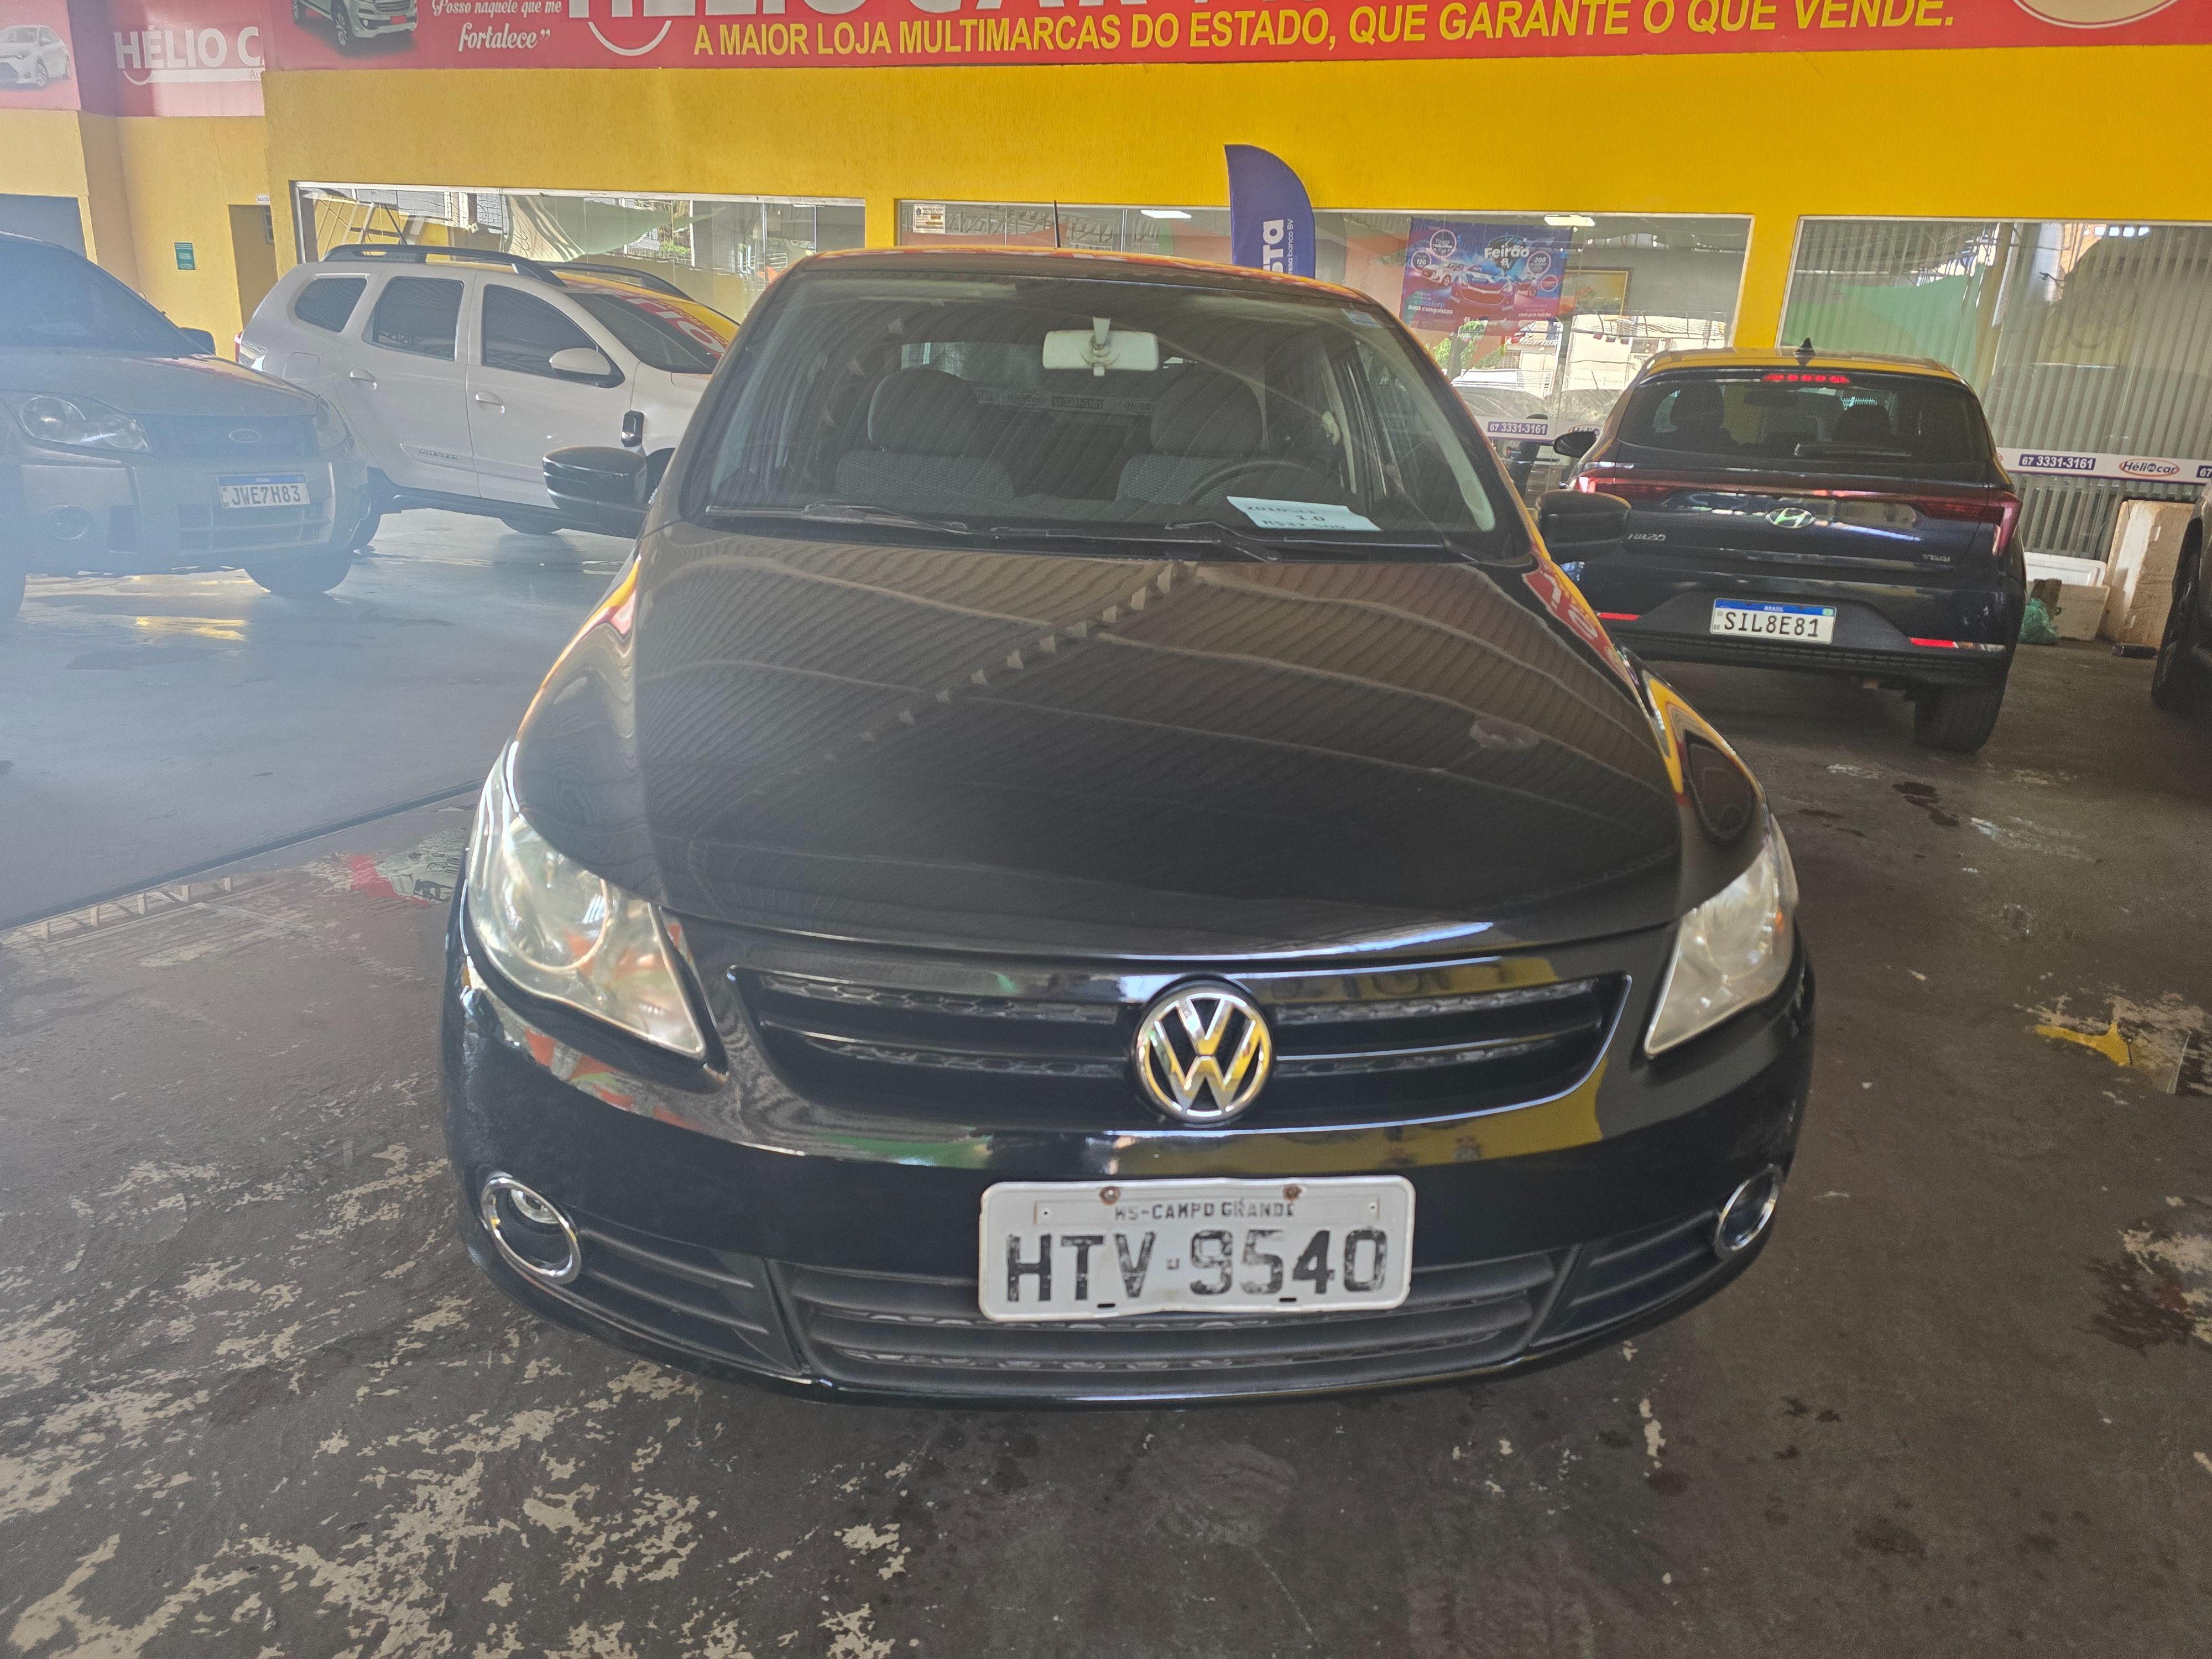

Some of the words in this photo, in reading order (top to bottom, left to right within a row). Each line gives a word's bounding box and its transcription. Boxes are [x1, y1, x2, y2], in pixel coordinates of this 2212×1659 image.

[474, 0, 517, 18] naquele
[521, 0, 542, 18] que
[545, 1, 562, 13] me
[694, 24, 713, 55] A
[721, 23, 808, 55] MAIOR
[818, 22, 891, 54] LOJA
[900, 14, 1120, 54] MULTIMARCAS
[1131, 13, 1179, 48] DO
[1190, 8, 1336, 51] ESTADO,
[1349, 4, 1428, 44] QUE
[1439, 0, 1630, 40] GARANTE
[1644, 0, 1676, 34] O
[1687, 0, 1776, 35] QUE
[1795, 0, 1953, 29] VENDE.
[114, 25, 227, 69] HÉLIO
[1287, 219, 1293, 229] BV
[1484, 244, 1530, 259] Feirão
[1490, 423, 1499, 431] 67
[1501, 422, 1546, 434] 3331-3161
[2022, 456, 2033, 466] 67
[2036, 455, 2094, 469] 3331-3161
[2200, 468, 2212, 477] 67
[231, 485, 301, 505] JWE7H83
[1724, 612, 1819, 638] SIL8E81
